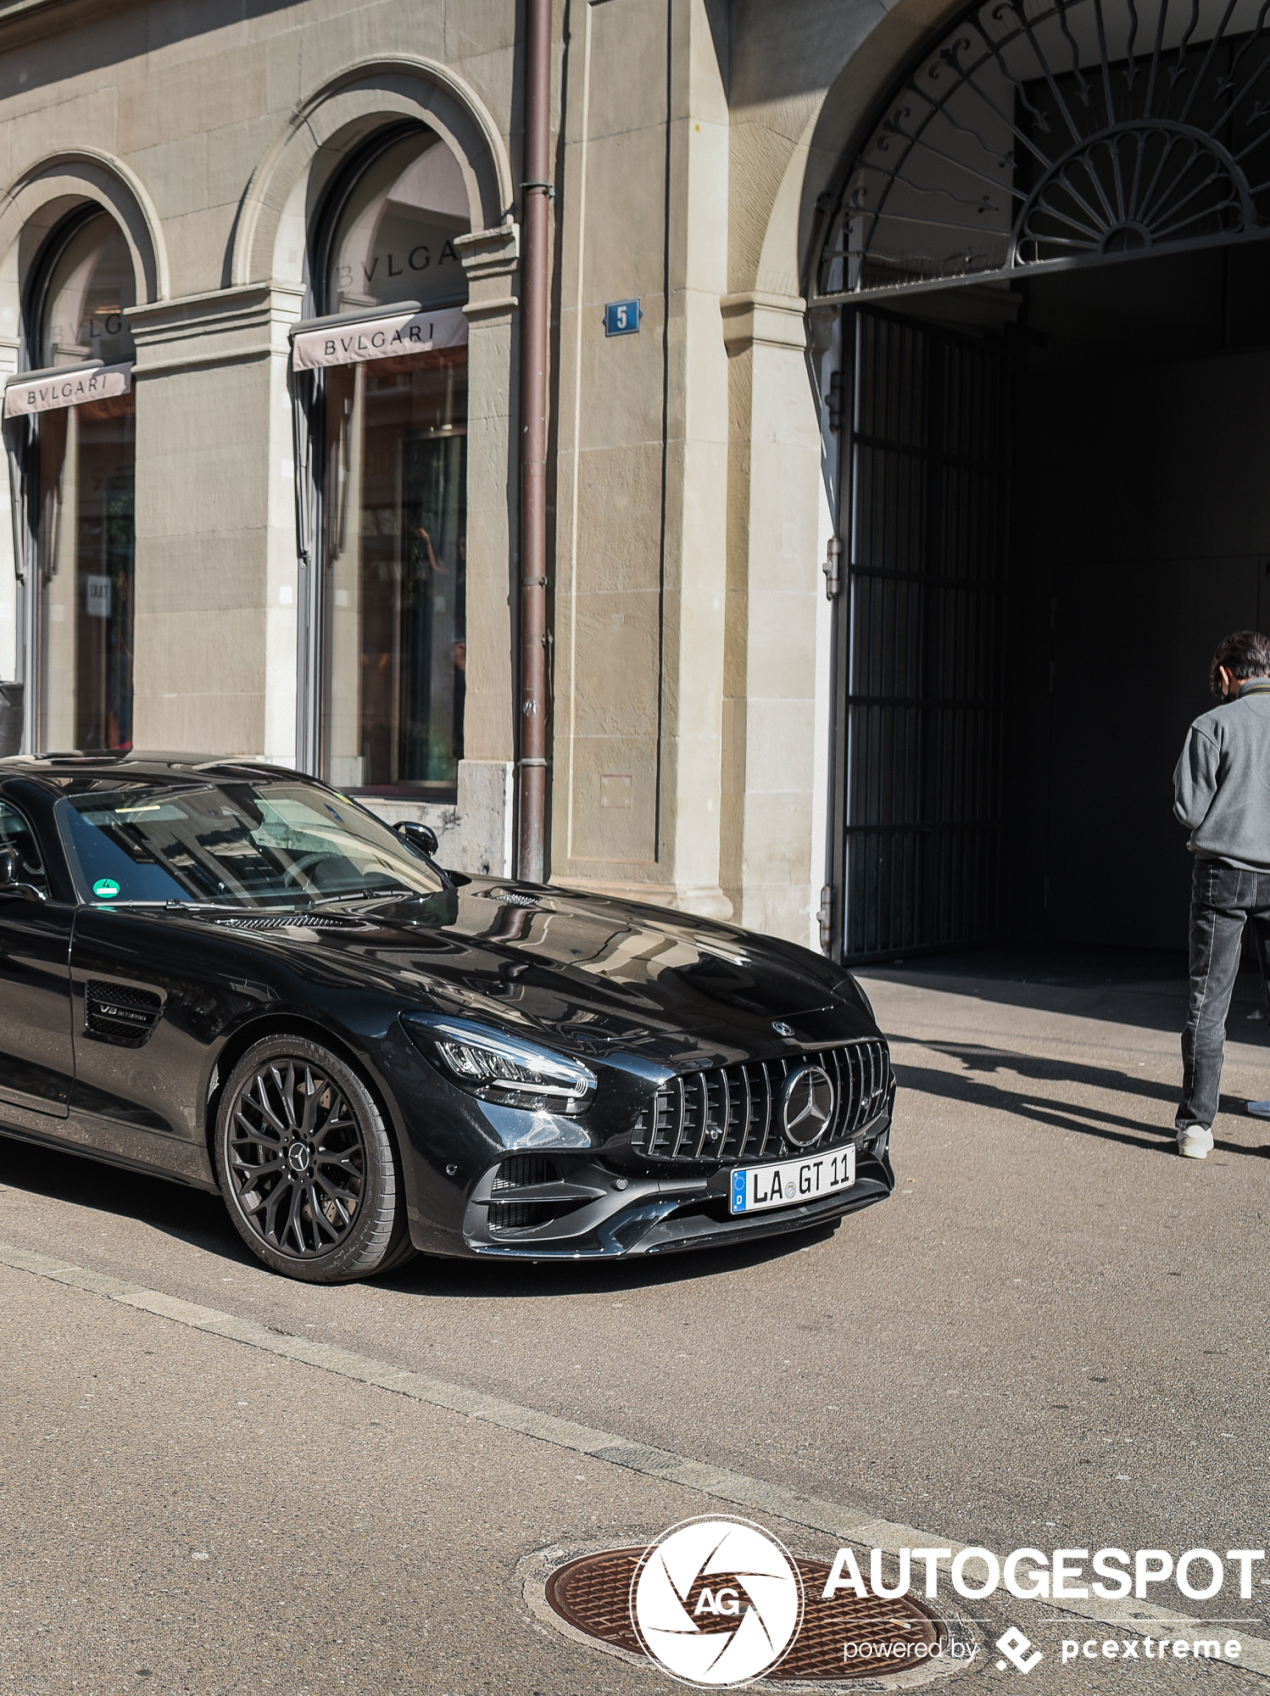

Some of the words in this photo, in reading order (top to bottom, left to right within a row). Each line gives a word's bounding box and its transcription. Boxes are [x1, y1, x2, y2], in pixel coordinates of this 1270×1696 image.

[617, 305, 627, 329] 5
[324, 322, 435, 356] BVLGARI
[27, 375, 107, 405] BVLGARI
[103, 879, 110, 888] 4
[99, 1004, 118, 1015] V8
[754, 1170, 783, 1204] LA
[799, 1161, 824, 1195] GT
[830, 1154, 850, 1187] 11
[736, 1195, 743, 1205] D
